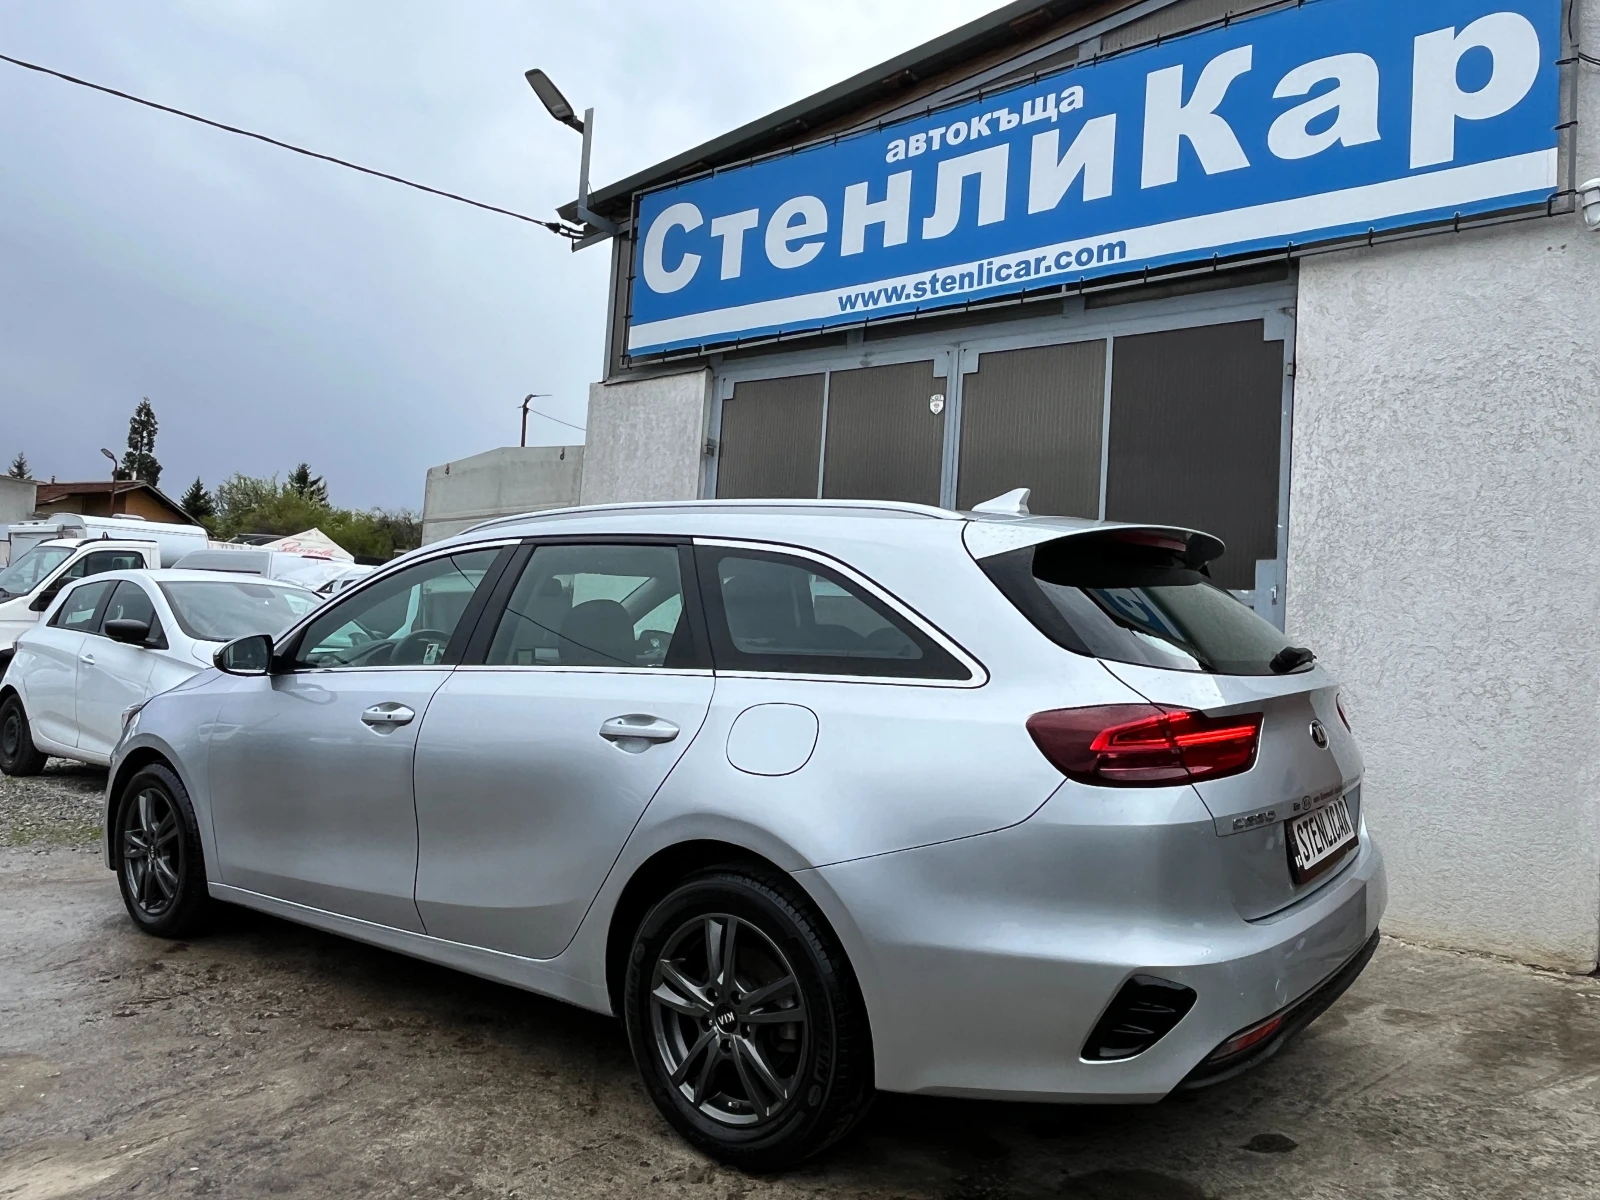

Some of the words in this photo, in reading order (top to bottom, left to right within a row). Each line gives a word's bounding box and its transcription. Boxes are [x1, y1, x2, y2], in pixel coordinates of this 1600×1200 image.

[643, 12, 1541, 294] СтенлиКар
[886, 86, 1084, 163] автокъща
[838, 241, 1127, 314] www.stenlicar.com
[1296, 800, 1351, 862] STENLICAR
[717, 1011, 735, 1025] KIA
